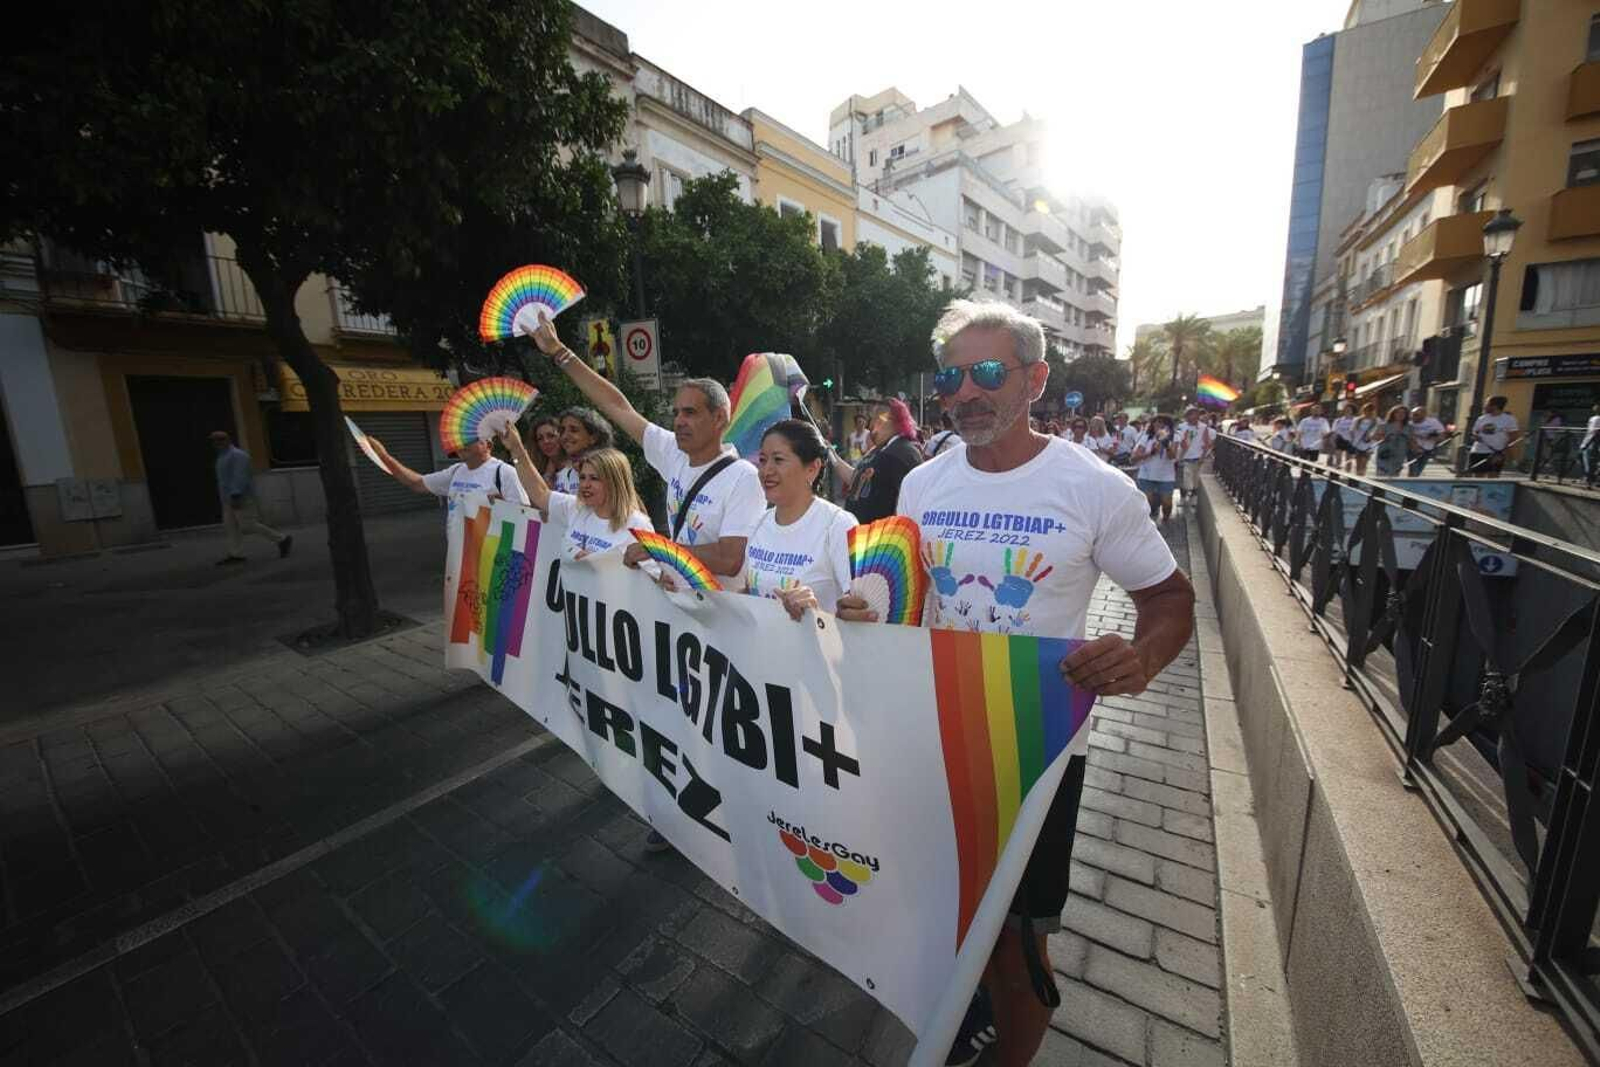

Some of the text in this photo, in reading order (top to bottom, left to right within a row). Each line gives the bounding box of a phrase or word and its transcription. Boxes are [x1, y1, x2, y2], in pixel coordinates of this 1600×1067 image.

[633, 337, 646, 352] 10
[348, 371, 398, 381] ORO
[290, 383, 425, 399] CREDERA
[922, 511, 1067, 535] ORGULLO LGTBIAP+
[938, 529, 1030, 547] JEREZ 2022
[654, 620, 861, 790] LGTBI+
